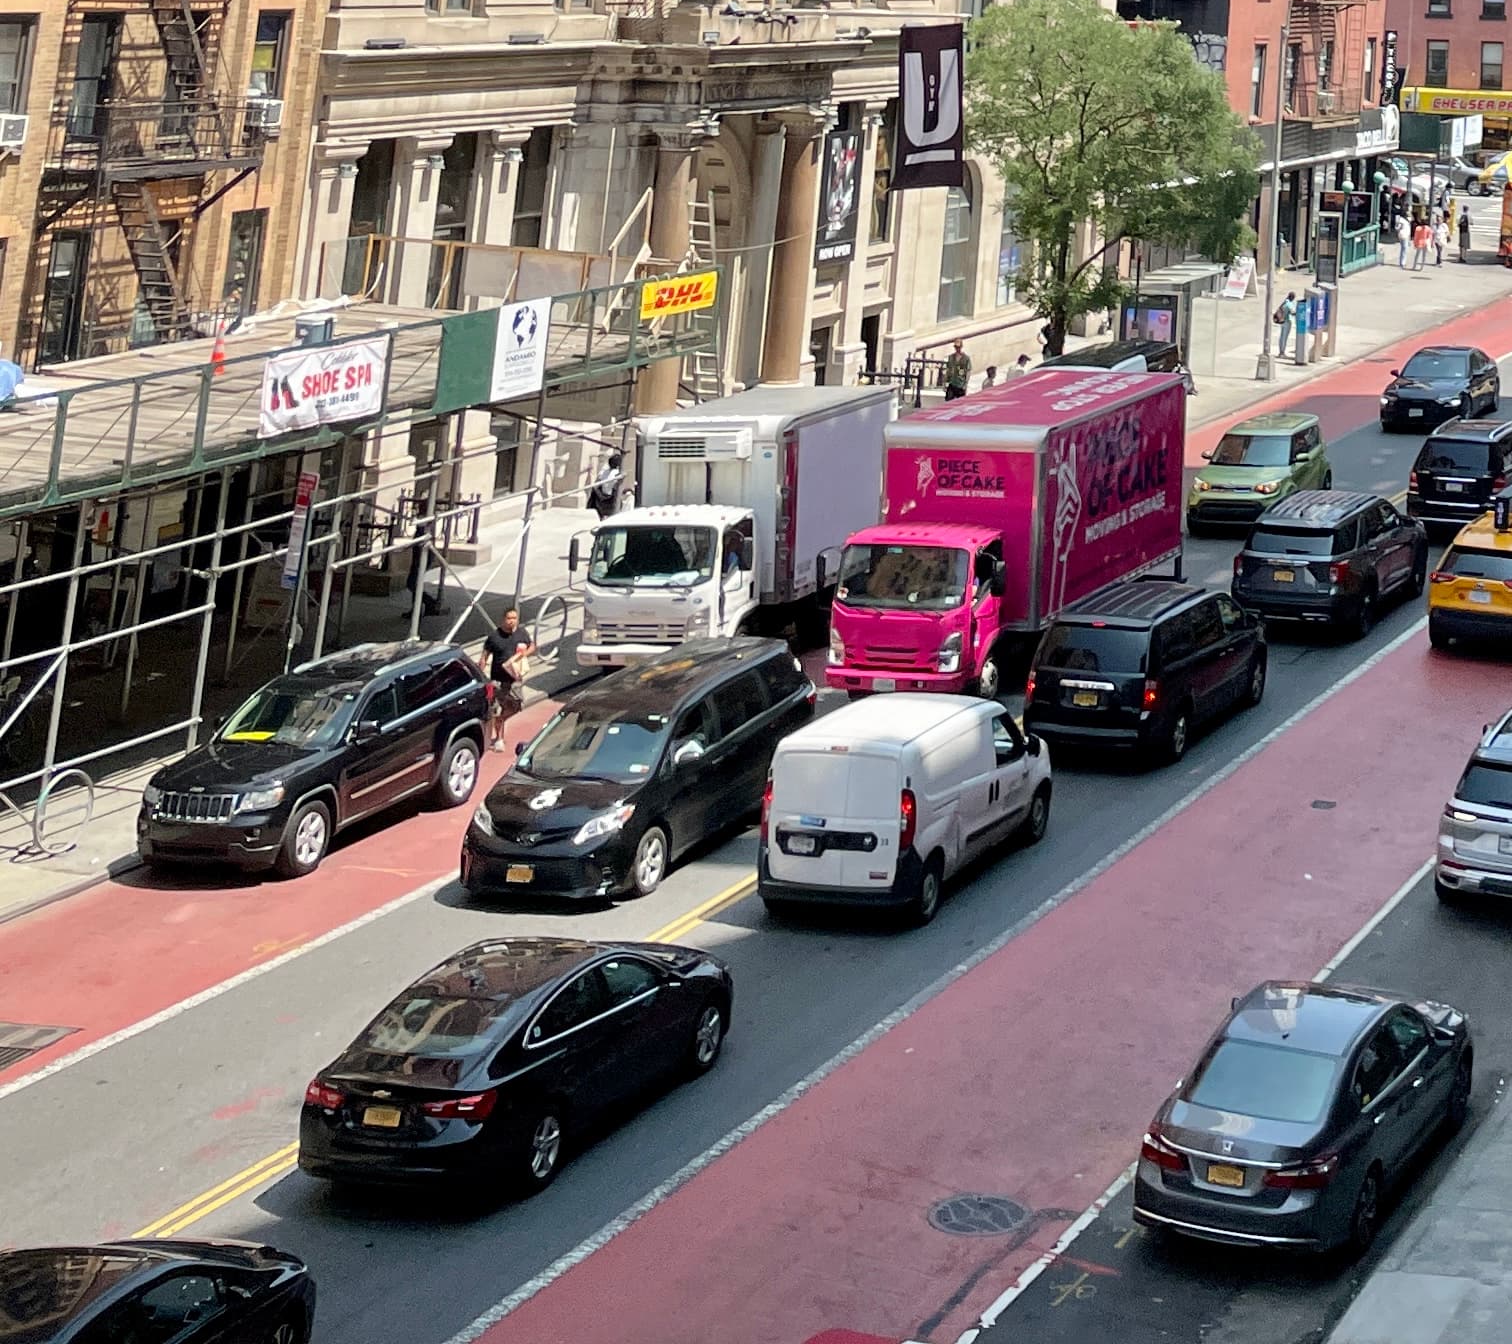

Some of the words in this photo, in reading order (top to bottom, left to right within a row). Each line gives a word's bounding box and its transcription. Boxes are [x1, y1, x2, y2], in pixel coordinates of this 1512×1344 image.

[1433, 98, 1495, 110] CHELSEA
[654, 282, 703, 309] DHL
[302, 369, 341, 400] SHOE
[344, 363, 372, 390] SPA
[937, 458, 980, 474] PIECE
[937, 474, 960, 488] OF
[961, 475, 1006, 490] CAKE
